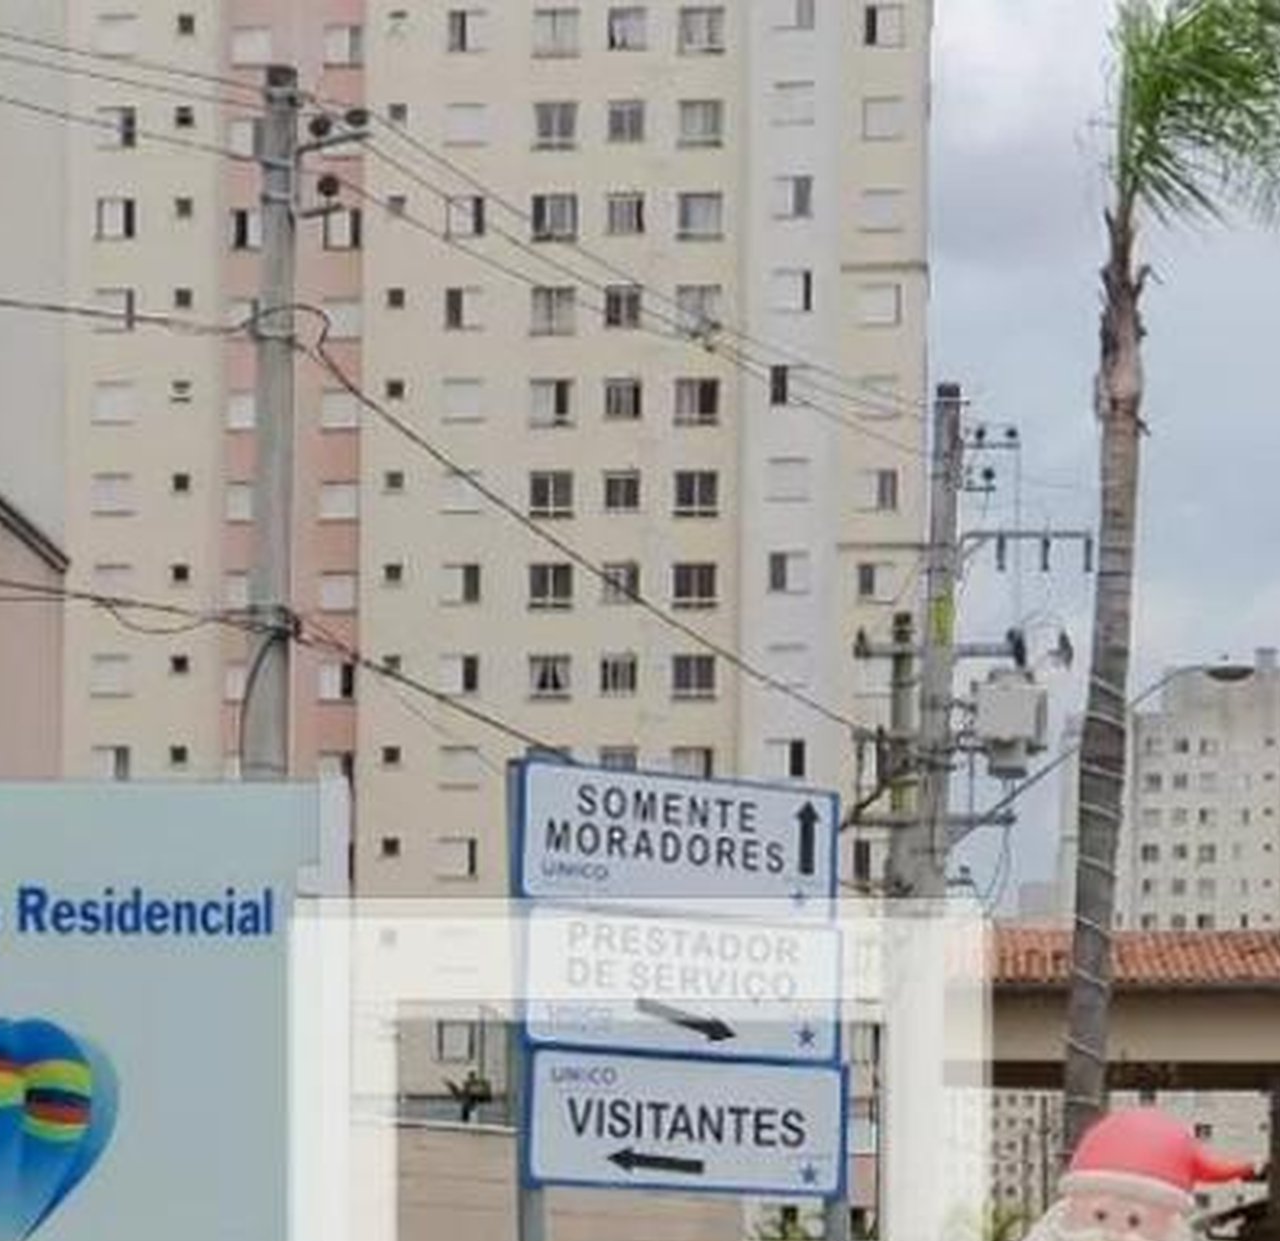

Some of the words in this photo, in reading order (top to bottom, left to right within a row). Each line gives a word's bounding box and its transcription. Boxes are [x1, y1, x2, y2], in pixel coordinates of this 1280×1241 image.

[576, 783, 758, 834] SOMENTE
[544, 819, 785, 874] MORADORES
[17, 885, 274, 937] Residencial
[565, 921, 803, 963] PRESTADOR
[566, 957, 620, 988] DE
[629, 962, 798, 1006] SERVIÇO
[567, 1096, 807, 1149] VISITANTES
